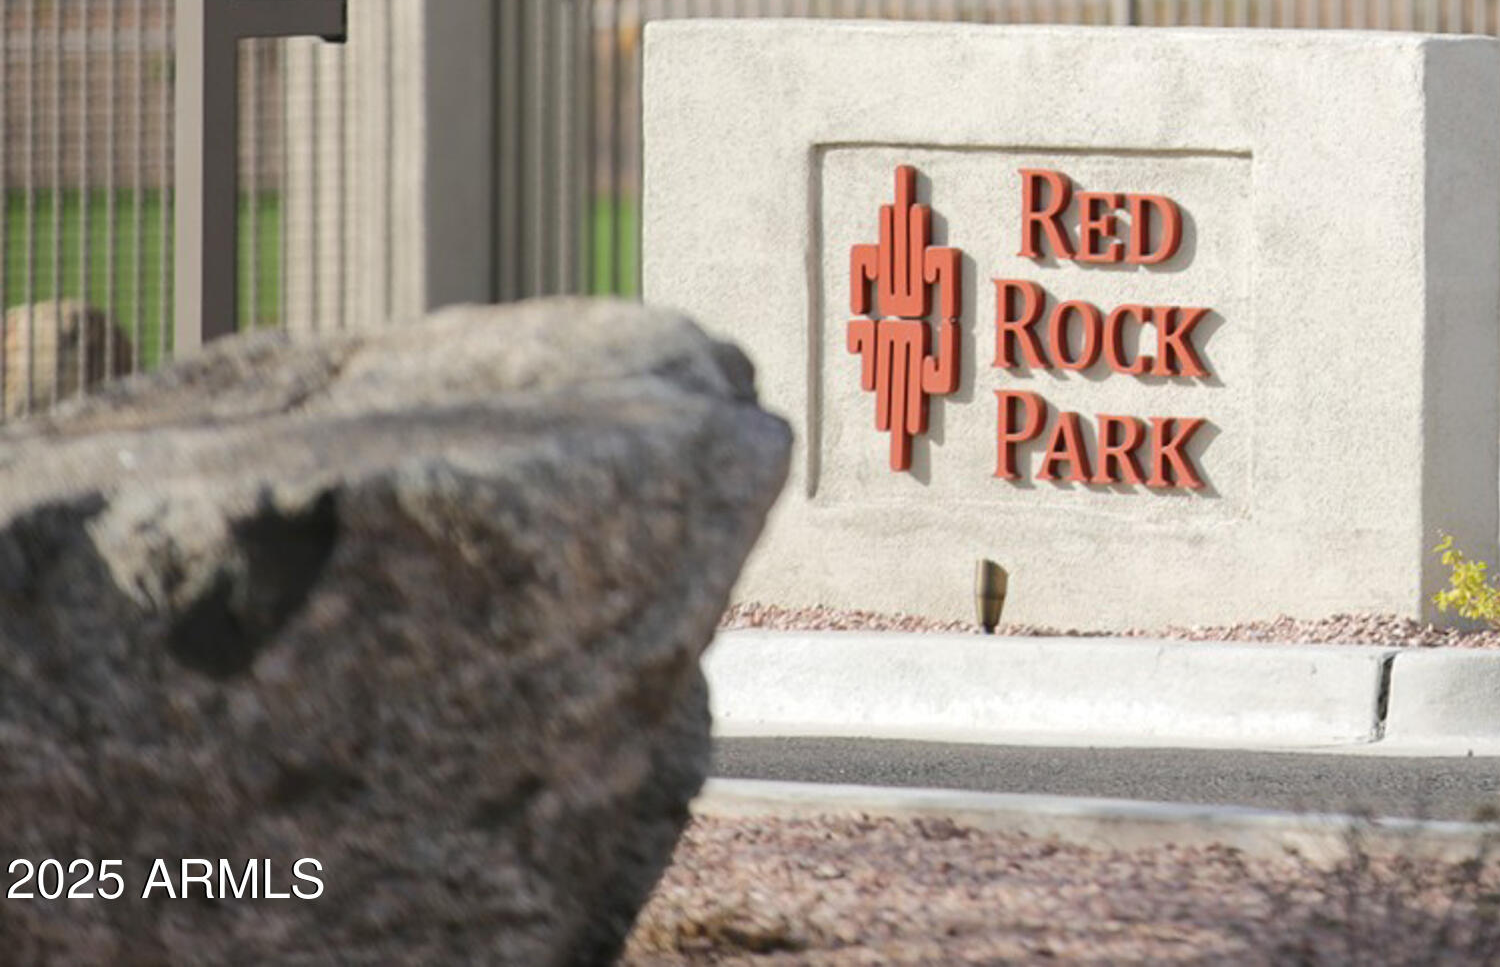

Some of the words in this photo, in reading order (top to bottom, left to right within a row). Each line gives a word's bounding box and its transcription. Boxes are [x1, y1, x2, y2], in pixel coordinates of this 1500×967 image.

[1016, 168, 1183, 265] RED
[991, 278, 1212, 377] ROCK
[992, 389, 1207, 490] PARK
